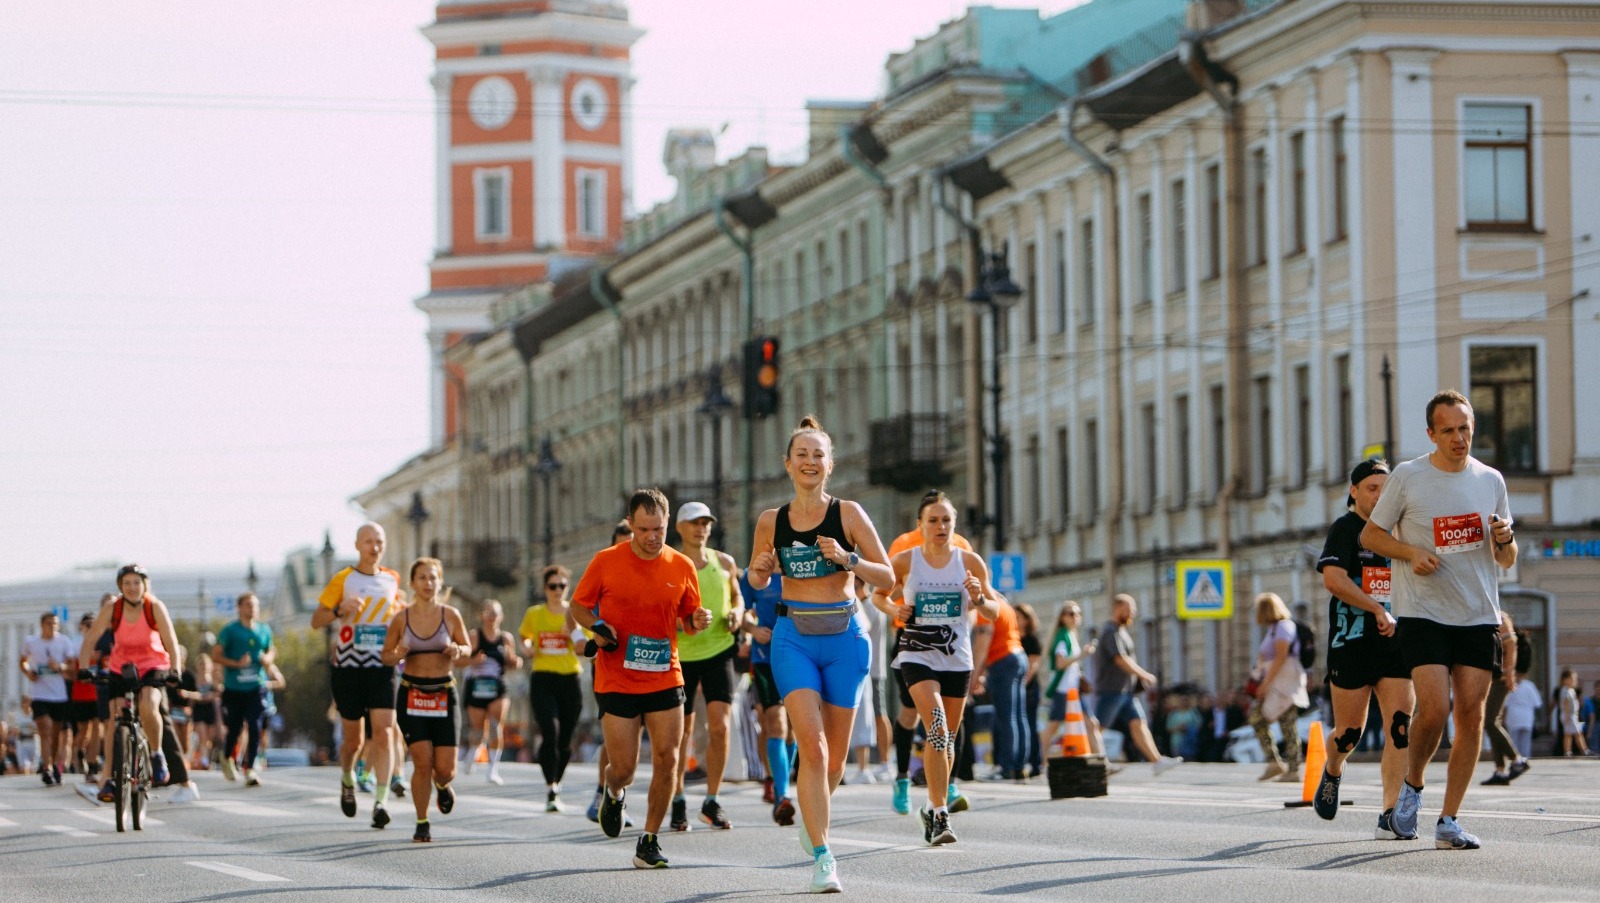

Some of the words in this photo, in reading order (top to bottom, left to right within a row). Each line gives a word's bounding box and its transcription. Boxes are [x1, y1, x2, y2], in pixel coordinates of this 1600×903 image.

[1440, 527, 1472, 540] 10041
[790, 561, 817, 572] 9337
[1370, 579, 1390, 589] 608
[922, 604, 948, 613] 4398
[1332, 616, 1364, 648] 24
[634, 648, 660, 660] 5077
